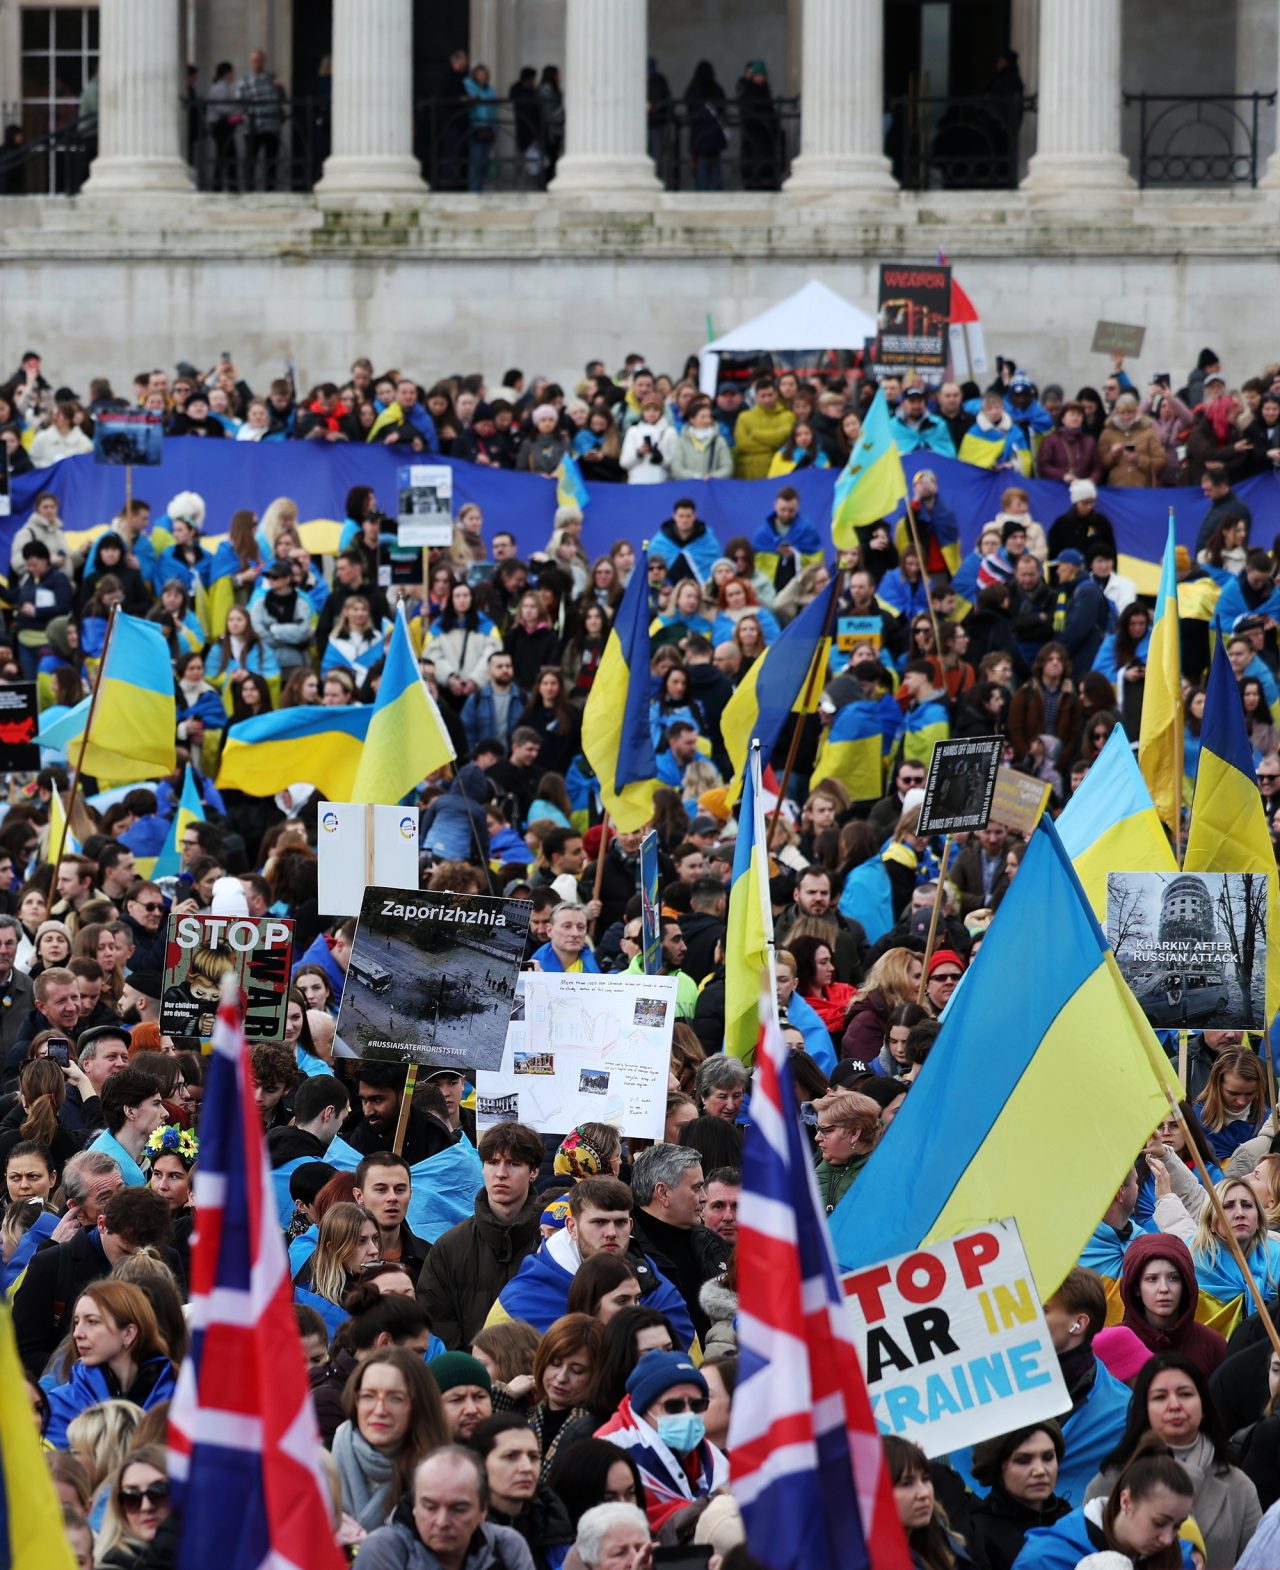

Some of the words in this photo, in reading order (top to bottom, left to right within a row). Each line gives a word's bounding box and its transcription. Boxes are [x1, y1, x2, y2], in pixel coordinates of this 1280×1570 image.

[942, 745, 958, 757] HANDS
[958, 744, 967, 755] OFF
[966, 743, 976, 754] OUR
[976, 741, 994, 754] FUTURE
[990, 741, 1001, 766] HANDS
[932, 746, 943, 774] FUTURE
[929, 775, 937, 791] OUR
[988, 766, 996, 780] OFF
[926, 792, 934, 805] OFF
[985, 781, 993, 796] OUR
[921, 805, 931, 831] HANDS
[980, 797, 991, 824] FUTURE
[928, 818, 944, 830] HANDS
[944, 817, 953, 828] OFF
[953, 816, 962, 827] OUR
[962, 814, 980, 827] FUTURE
[381, 900, 506, 927] Zaporizhzhia
[176, 917, 289, 951] STOP
[1136, 939, 1190, 951] KHARKIV
[1194, 941, 1232, 951] AFTER
[1133, 951, 1187, 963] RUSSIAN
[1190, 953, 1239, 963] ATTACK
[245, 948, 288, 1037] WAR
[164, 1001, 174, 1009] Our
[175, 1001, 199, 1010] children
[368, 1040, 468, 1056] #RUSSIAISATERRORISTSTATE
[842, 1232, 1000, 1325] TOP
[867, 1307, 960, 1385] AR
[977, 1278, 1038, 1336] IN
[869, 1339, 1052, 1436] RAINE
